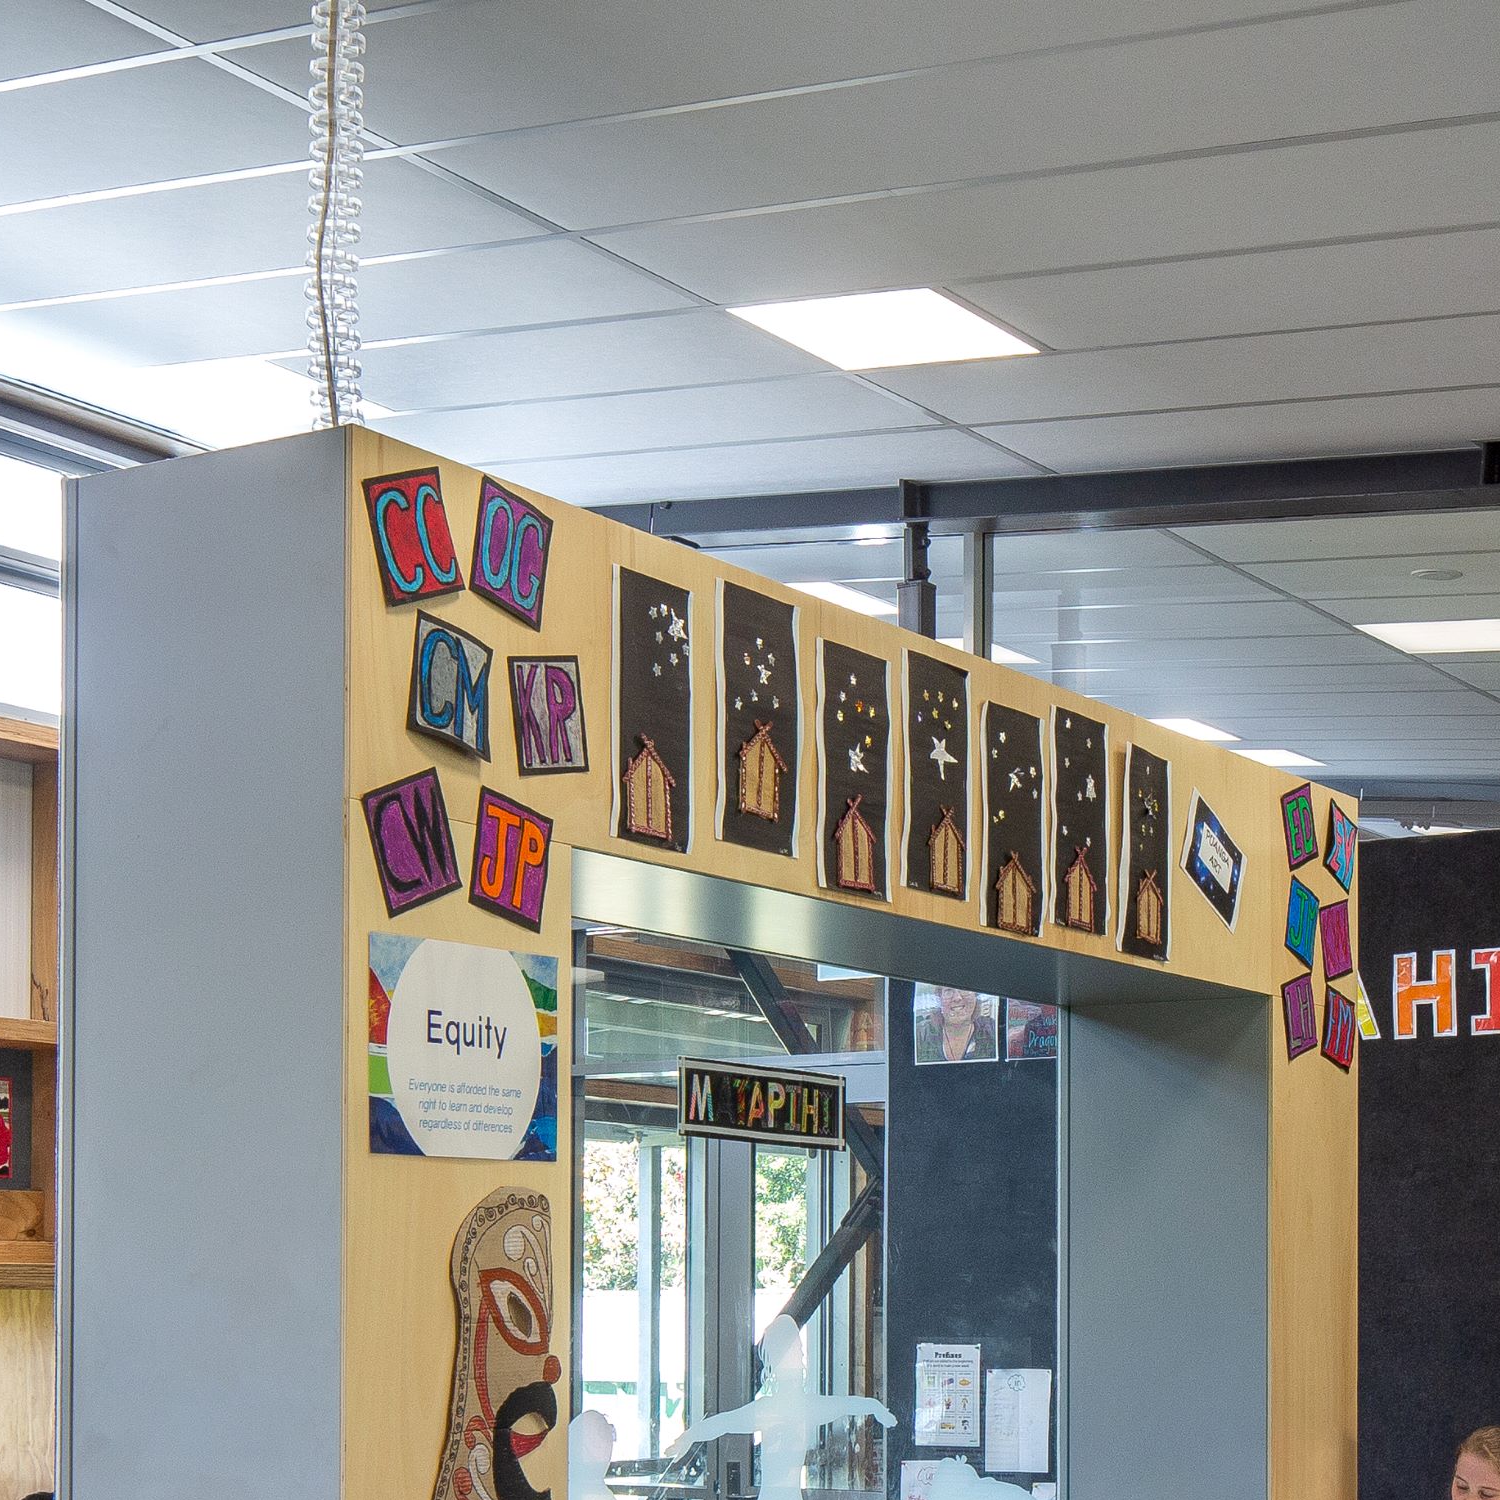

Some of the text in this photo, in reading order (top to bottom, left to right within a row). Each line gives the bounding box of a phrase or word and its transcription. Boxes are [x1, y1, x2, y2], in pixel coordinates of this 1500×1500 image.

[373, 485, 457, 593] CC
[419, 627, 488, 751] CM
[514, 660, 576, 769] KR
[373, 788, 451, 895] CW
[479, 802, 546, 908] JP
[1206, 829, 1231, 868] PUANGA
[1286, 796, 1314, 859] ED
[1209, 855, 1222, 876] ART
[426, 1009, 508, 1060] Equity
[409, 1078, 522, 1098] Everyone is afforded the same
[418, 1098, 514, 1118] right to learn and develop
[418, 1117, 513, 1133] regardless of differences
